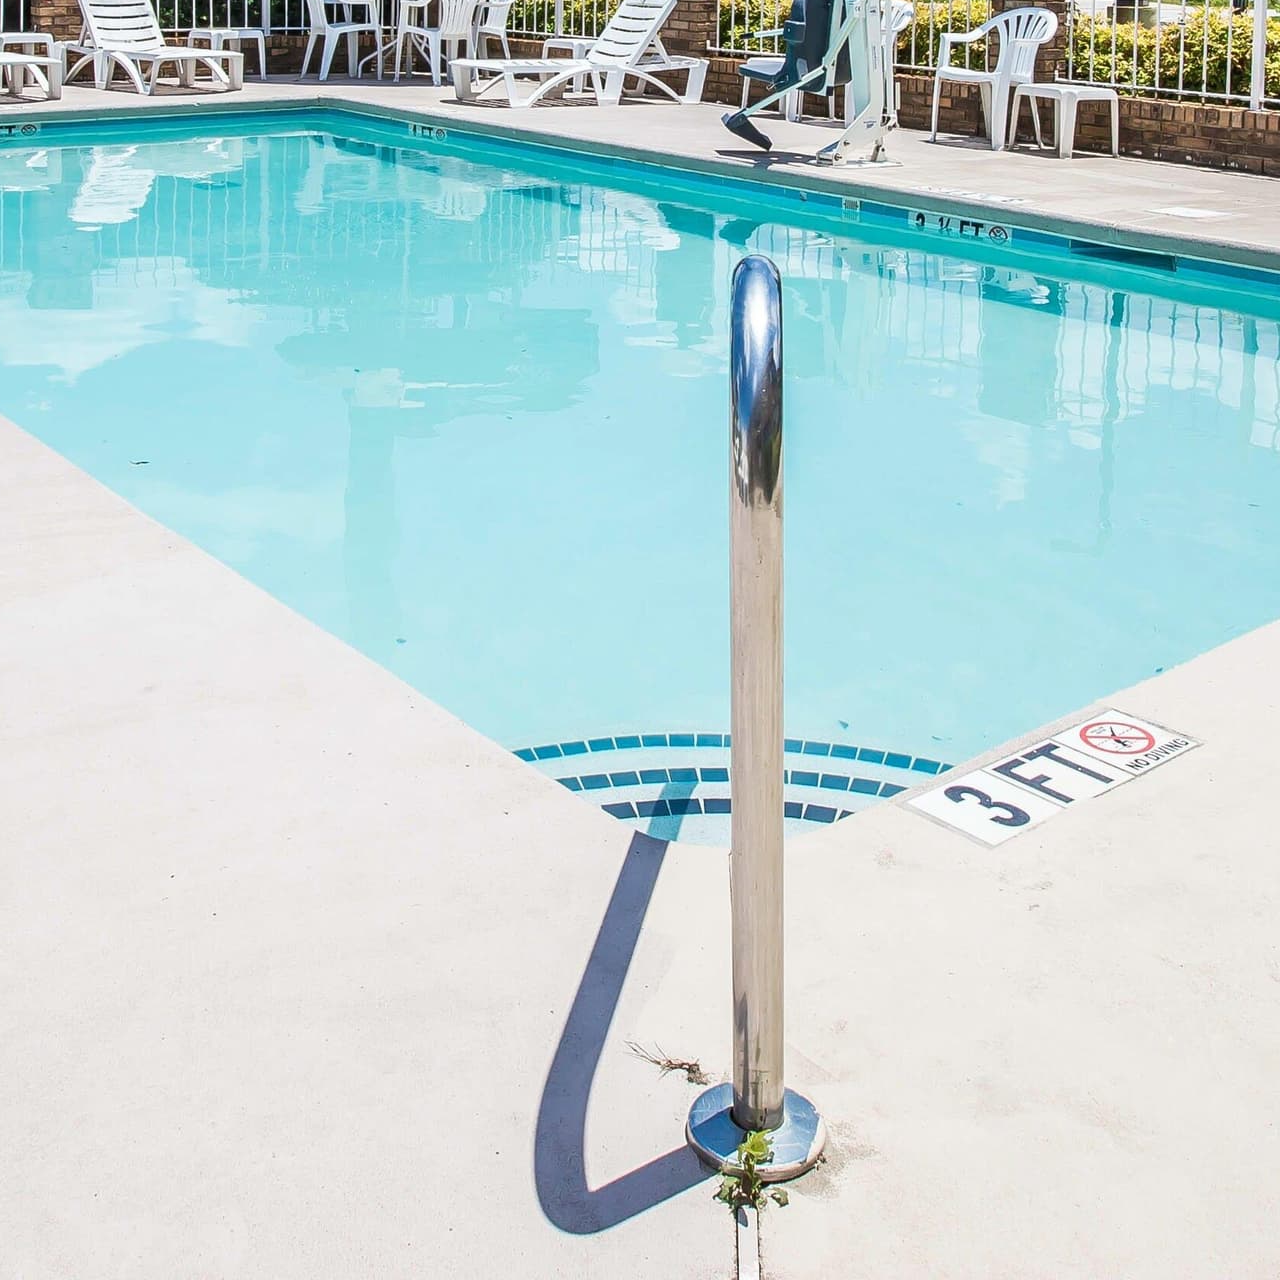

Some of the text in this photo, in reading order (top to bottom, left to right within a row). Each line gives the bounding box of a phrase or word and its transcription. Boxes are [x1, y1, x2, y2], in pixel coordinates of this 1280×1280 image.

[1125, 738, 1189, 771] NO DIVING
[943, 742, 1115, 827] 3 FT
